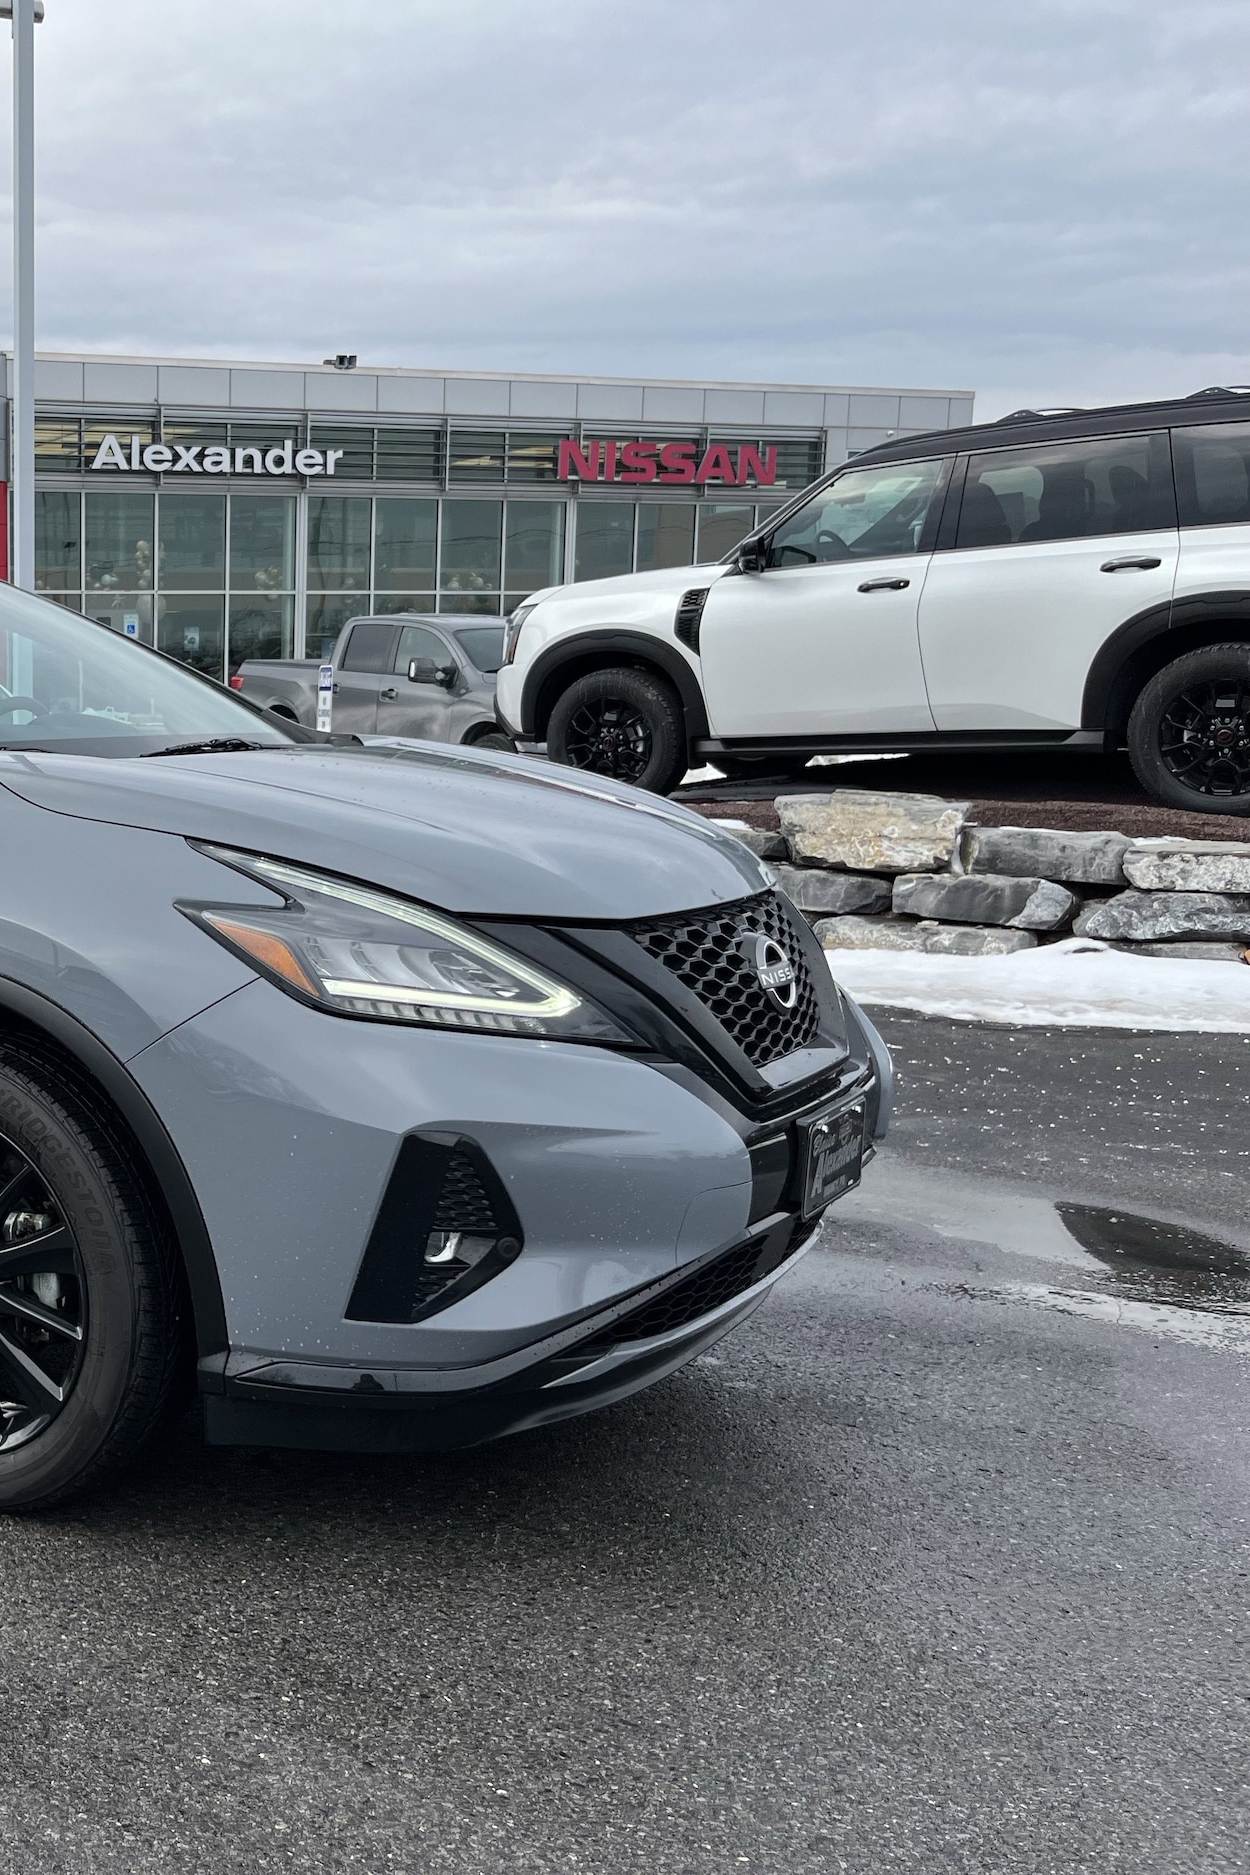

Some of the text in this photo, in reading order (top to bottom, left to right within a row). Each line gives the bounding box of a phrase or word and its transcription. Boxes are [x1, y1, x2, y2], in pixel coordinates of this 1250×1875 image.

[91, 434, 343, 475] Alexander
[558, 438, 778, 485] NISSAN
[760, 967, 792, 986] NISS
